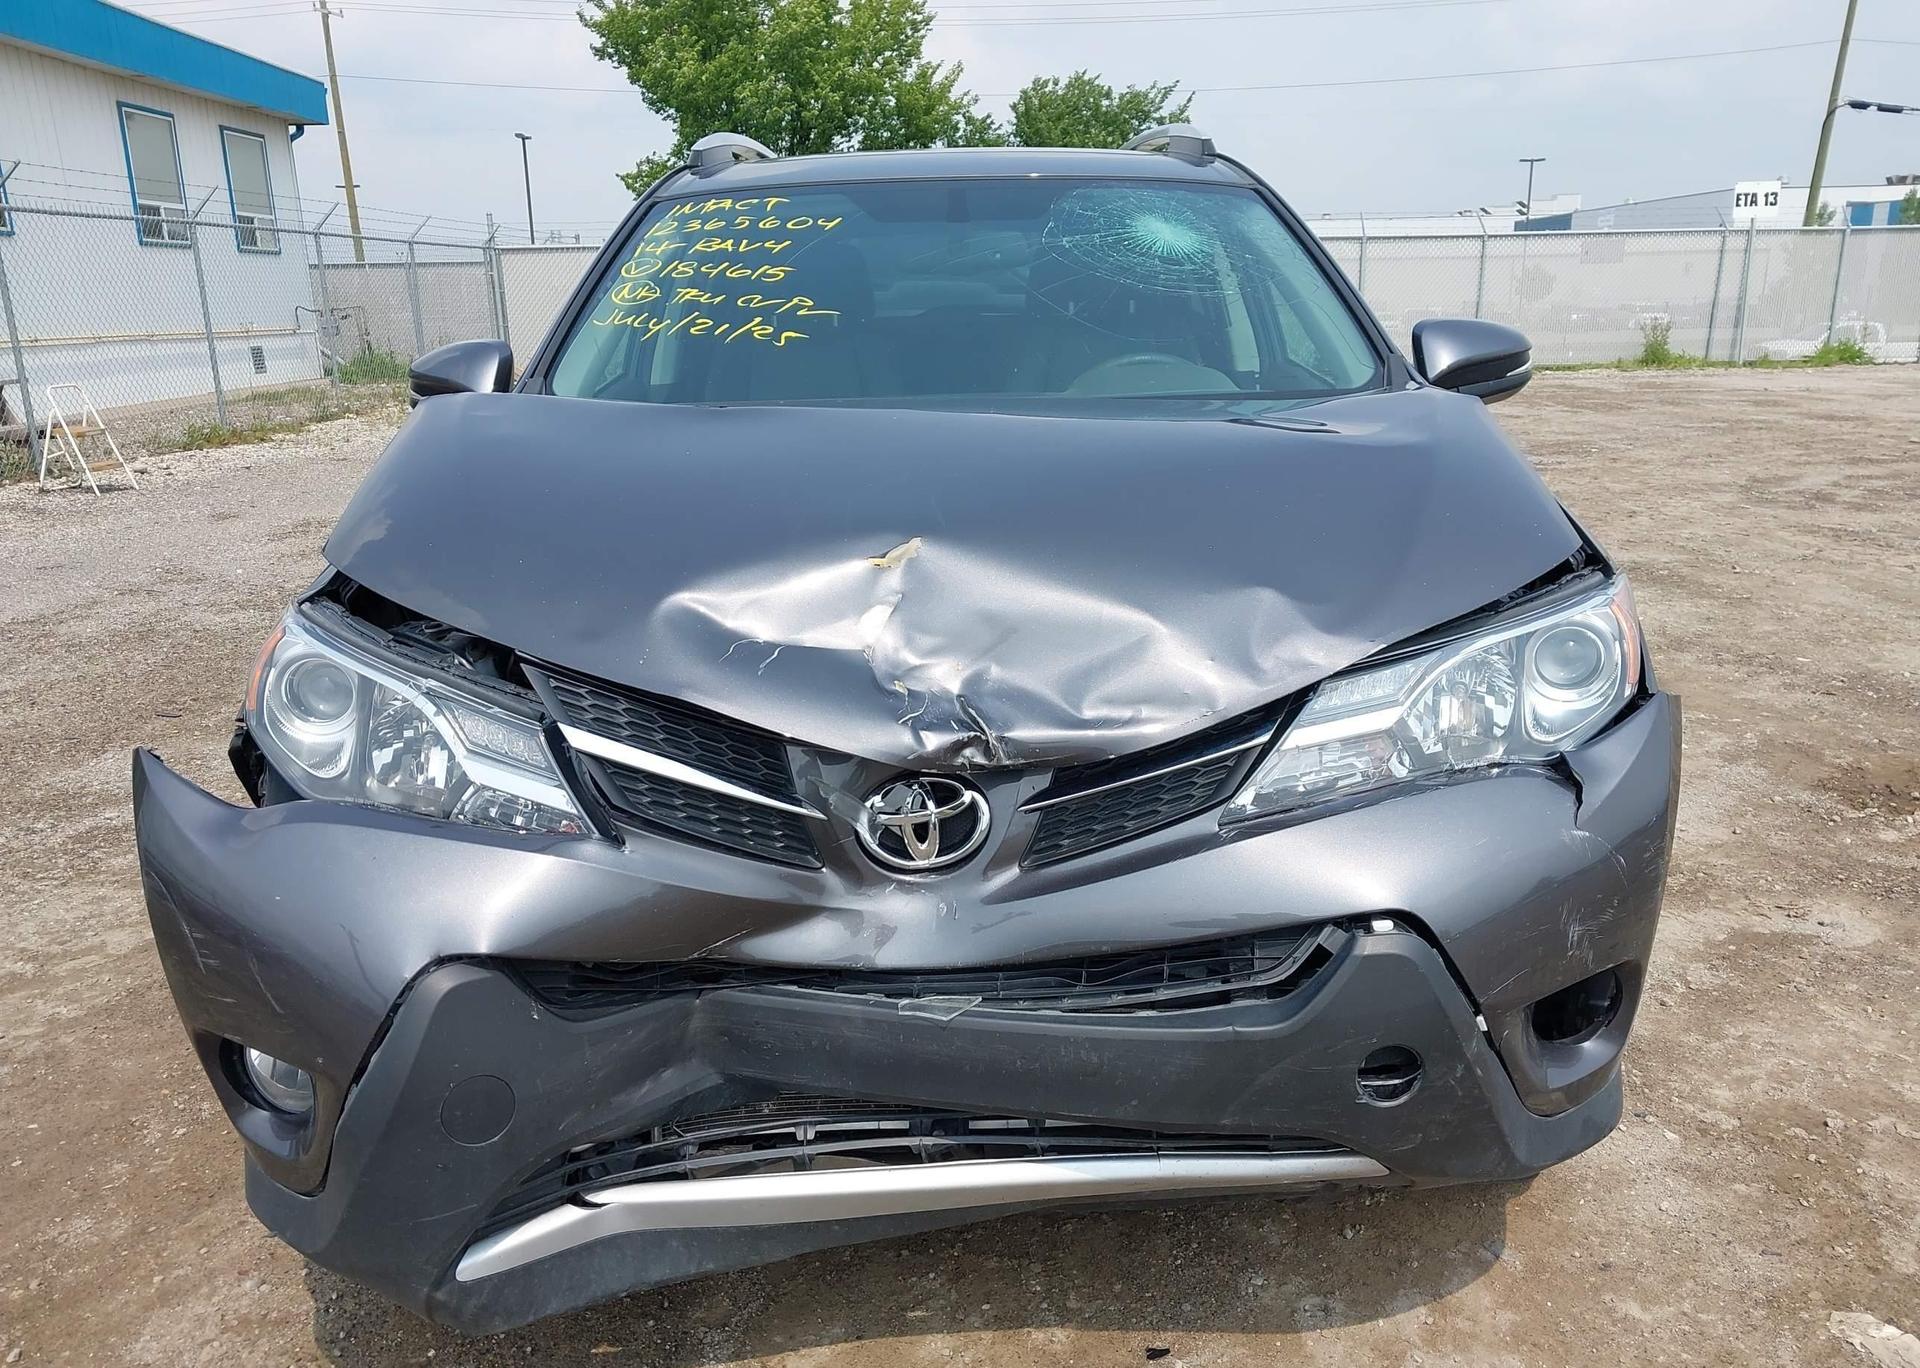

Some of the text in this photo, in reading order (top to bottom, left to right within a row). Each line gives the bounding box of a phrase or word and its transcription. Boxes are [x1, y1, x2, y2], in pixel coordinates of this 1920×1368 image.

[666, 197, 790, 217] INTACT
[1735, 192, 1779, 207] ETA 13
[645, 216, 843, 238] 12365604
[688, 237, 792, 254] RAV4
[659, 260, 797, 282] 184615
